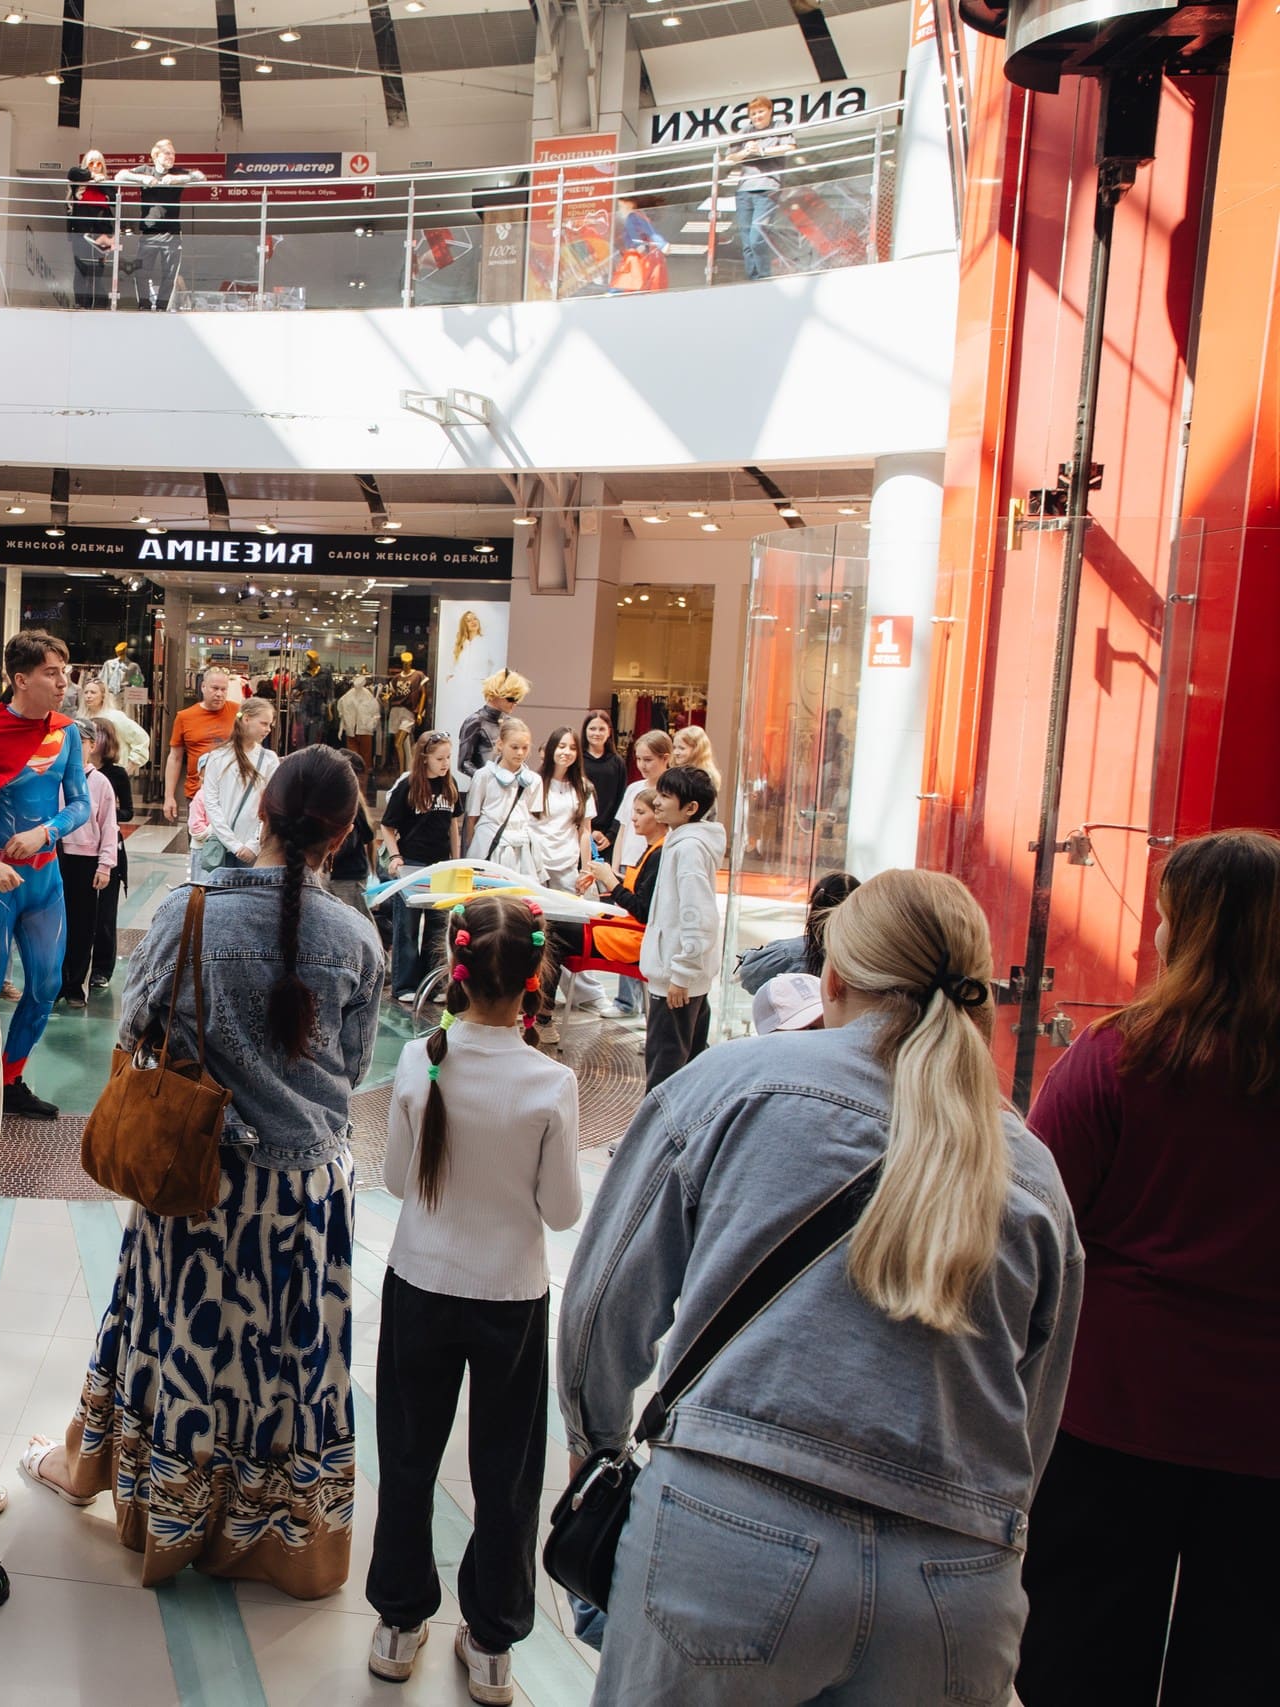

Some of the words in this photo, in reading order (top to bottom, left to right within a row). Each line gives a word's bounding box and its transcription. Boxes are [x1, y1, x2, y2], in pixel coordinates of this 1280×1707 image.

[6, 540, 65, 550] ЖЕНСКОЙ
[71, 543, 124, 554] ОДЕЖДЫ
[138, 538, 313, 565] АМНЕЗИЯ
[328, 550, 371, 560] САЛОН
[376, 551, 438, 562] ЖЕНСКОЙ
[443, 553, 499, 564] ОДЕЖДЫ
[875, 619, 899, 653] 1
